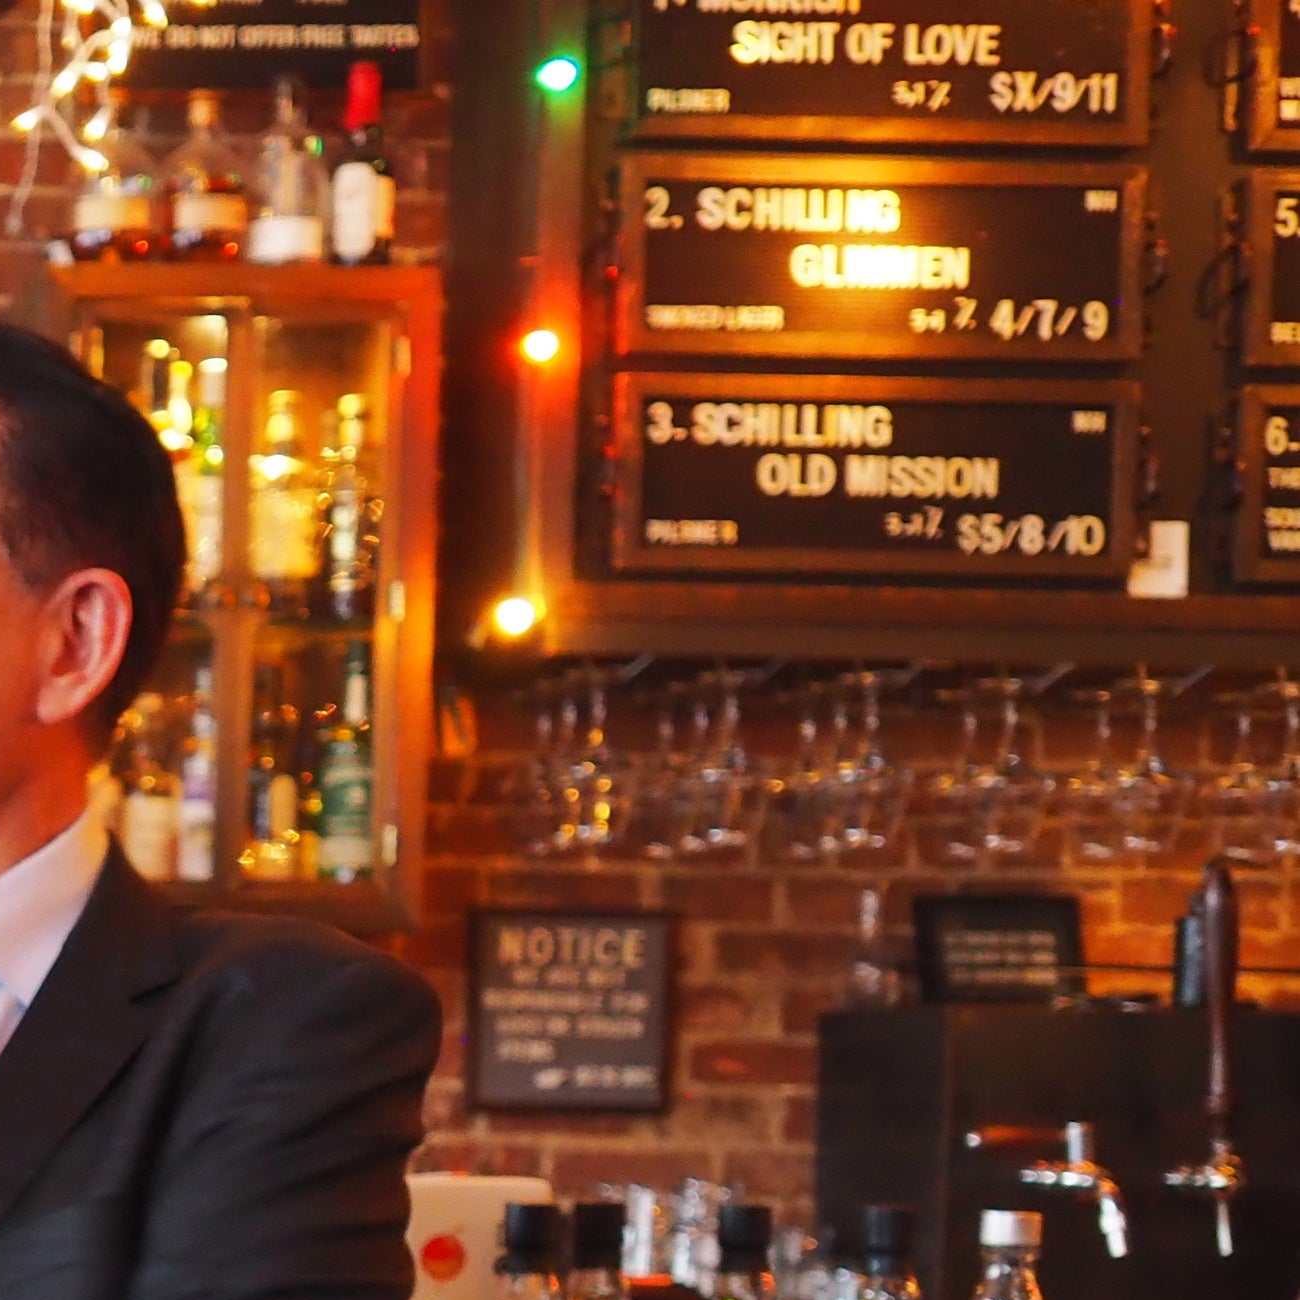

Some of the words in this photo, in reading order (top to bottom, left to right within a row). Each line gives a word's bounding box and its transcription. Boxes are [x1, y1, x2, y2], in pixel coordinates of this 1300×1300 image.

[729, 20, 841, 65] SIGHT
[844, 22, 896, 65] OF
[902, 23, 1002, 66] LOVE
[644, 186, 685, 230] 2.
[695, 186, 901, 234] SCHILLING
[647, 401, 689, 446] 3.
[690, 401, 894, 449] SCHILLING
[755, 452, 838, 498] OLD
[843, 453, 1000, 500] MISSION
[956, 511, 1106, 556] $5/8/10
[498, 925, 647, 969] NOTICE
